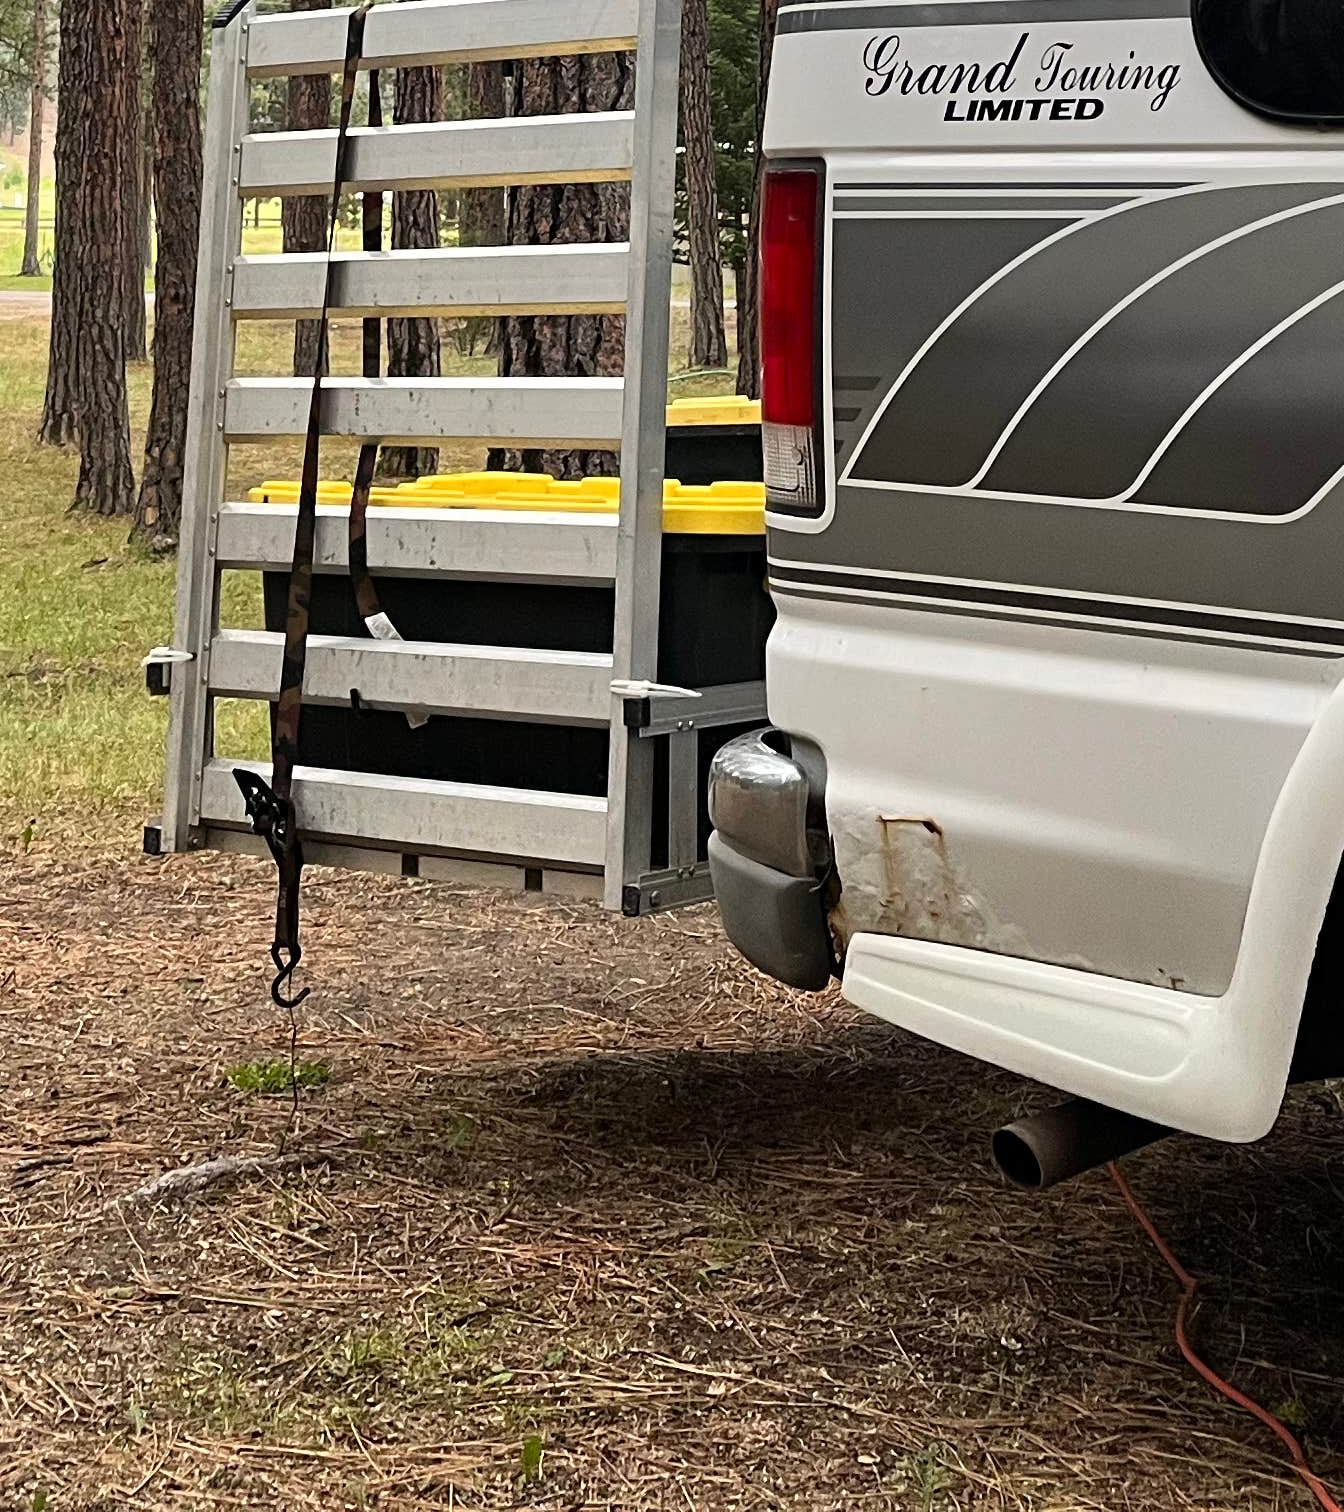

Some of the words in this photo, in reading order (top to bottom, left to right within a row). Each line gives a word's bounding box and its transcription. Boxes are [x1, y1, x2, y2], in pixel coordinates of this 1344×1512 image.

[863, 33, 1029, 96] Grand
[1035, 42, 1181, 112] Touring
[943, 98, 1105, 122] LIMITED
